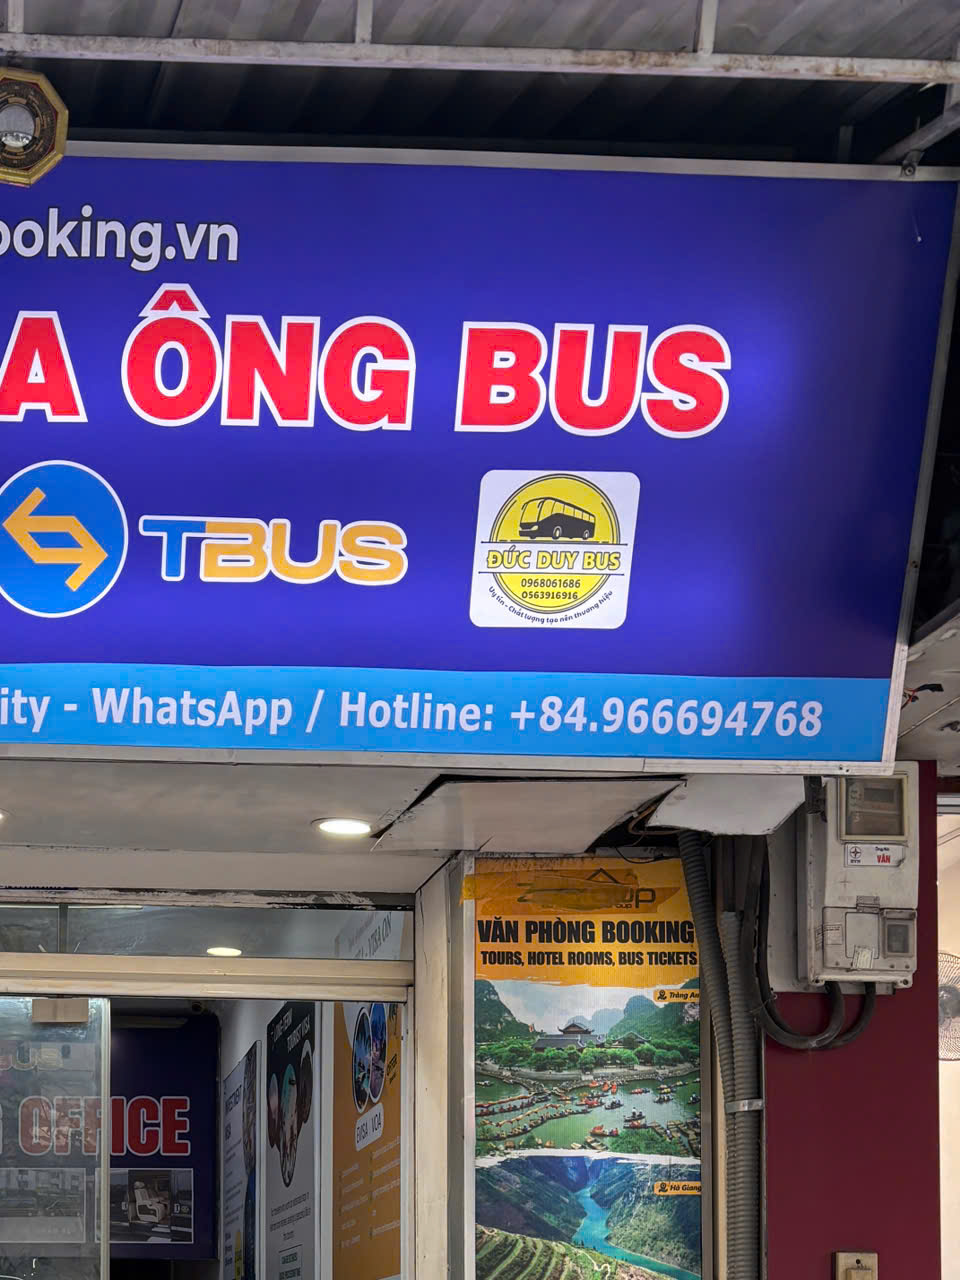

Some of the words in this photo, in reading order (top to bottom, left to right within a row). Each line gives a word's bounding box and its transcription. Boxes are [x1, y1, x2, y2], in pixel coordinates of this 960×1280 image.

[121, 283, 416, 432] ÔNG
[454, 321, 731, 440] BUS
[139, 514, 408, 587] TBUS
[486, 545, 531, 569] ĐỨC
[536, 550, 579, 570] DUY
[582, 552, 621, 570] BUS
[521, 578, 581, 588] 0968061686
[521, 591, 578, 600] 0563916916
[92, 686, 293, 736] WhatsApp
[305, 689, 326, 734] /
[340, 690, 494, 733] Hotline:
[510, 695, 823, 738] +84.966694768
[477, 917, 519, 944] VĂN
[524, 917, 596, 944] PHÒNG
[601, 919, 695, 944] BOOKING
[480, 950, 525, 968] TOURS,
[527, 951, 565, 966] HOTEL
[567, 951, 616, 967] ROOMS,
[618, 951, 644, 966] BUS
[646, 951, 698, 966] TICKETS
[18, 1095, 191, 1157] OFFICE
